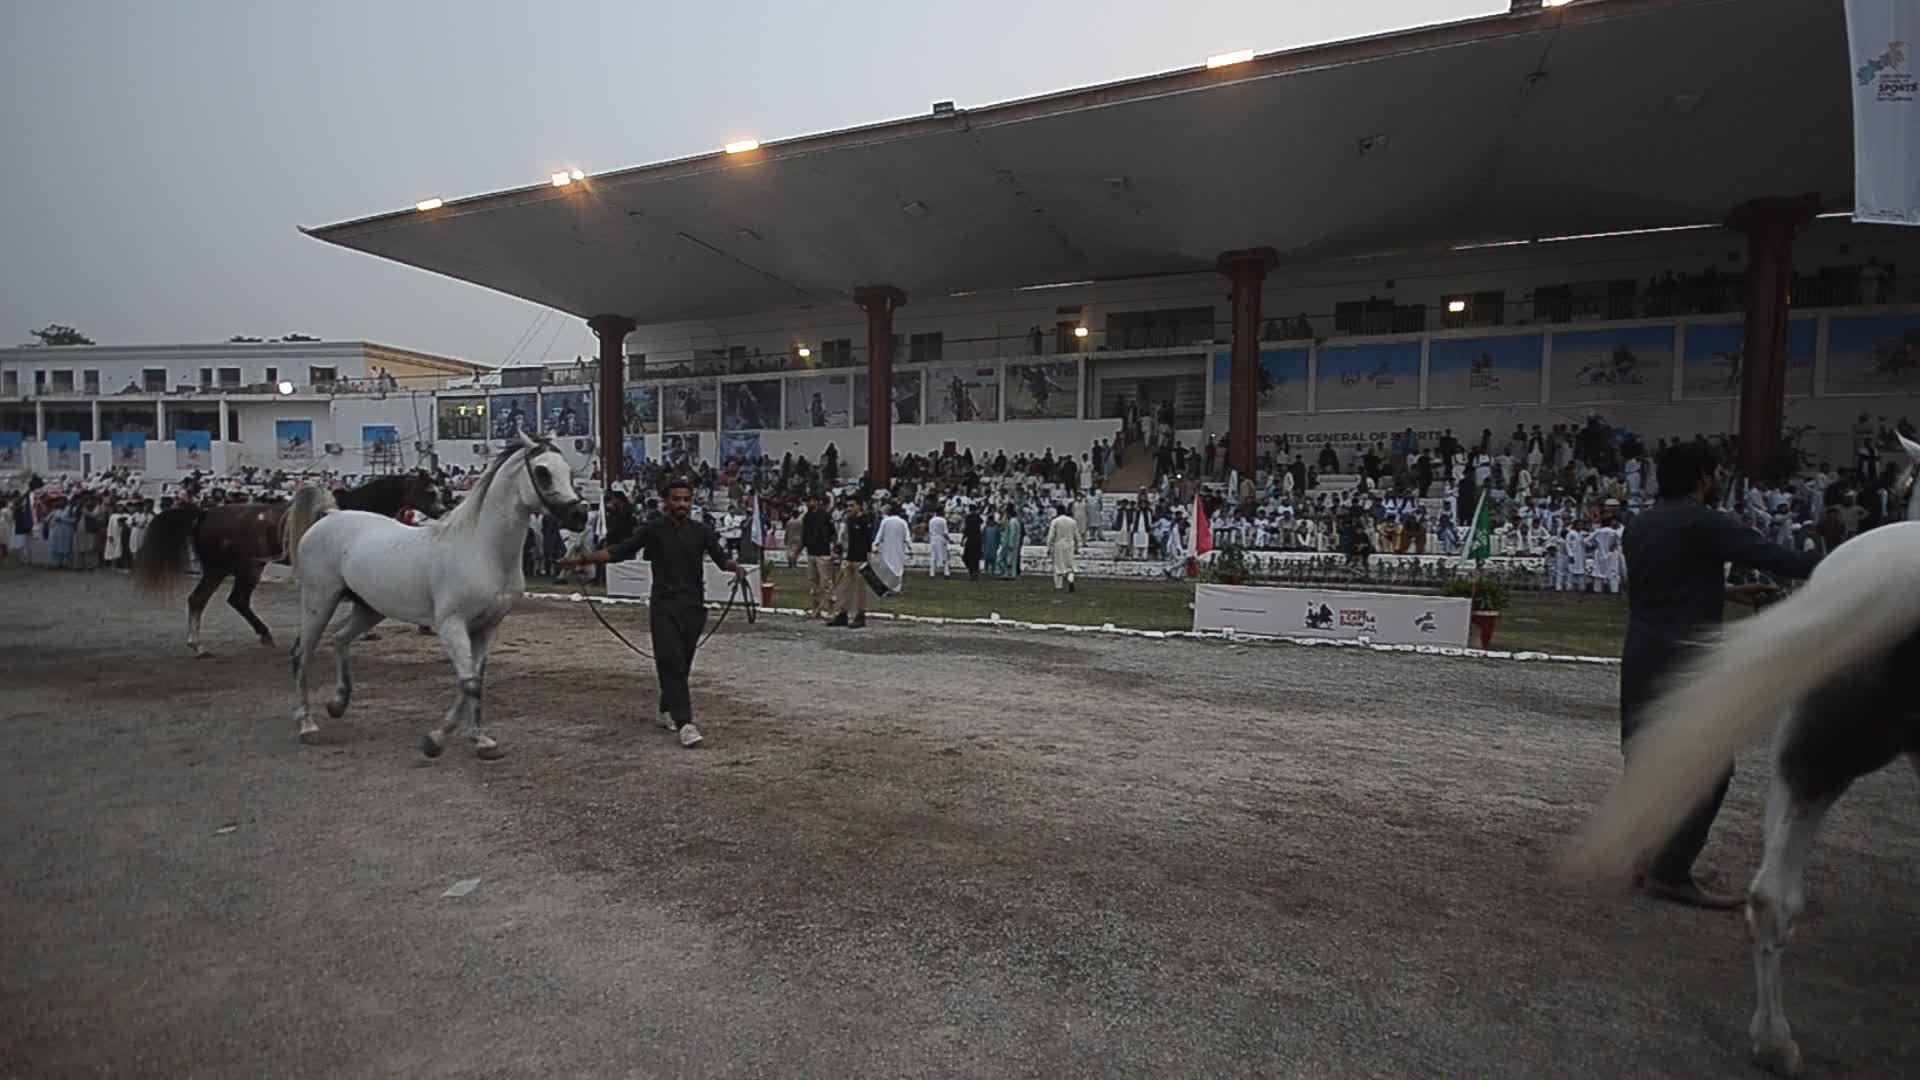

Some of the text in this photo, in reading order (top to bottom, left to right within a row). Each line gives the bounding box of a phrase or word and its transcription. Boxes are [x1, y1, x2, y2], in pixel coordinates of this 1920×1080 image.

[1879, 83, 1918, 93] SPORTS
[1306, 432, 1367, 442] GENERAL
[1369, 432, 1387, 441] OF
[1391, 431, 1442, 441] SPRTS
